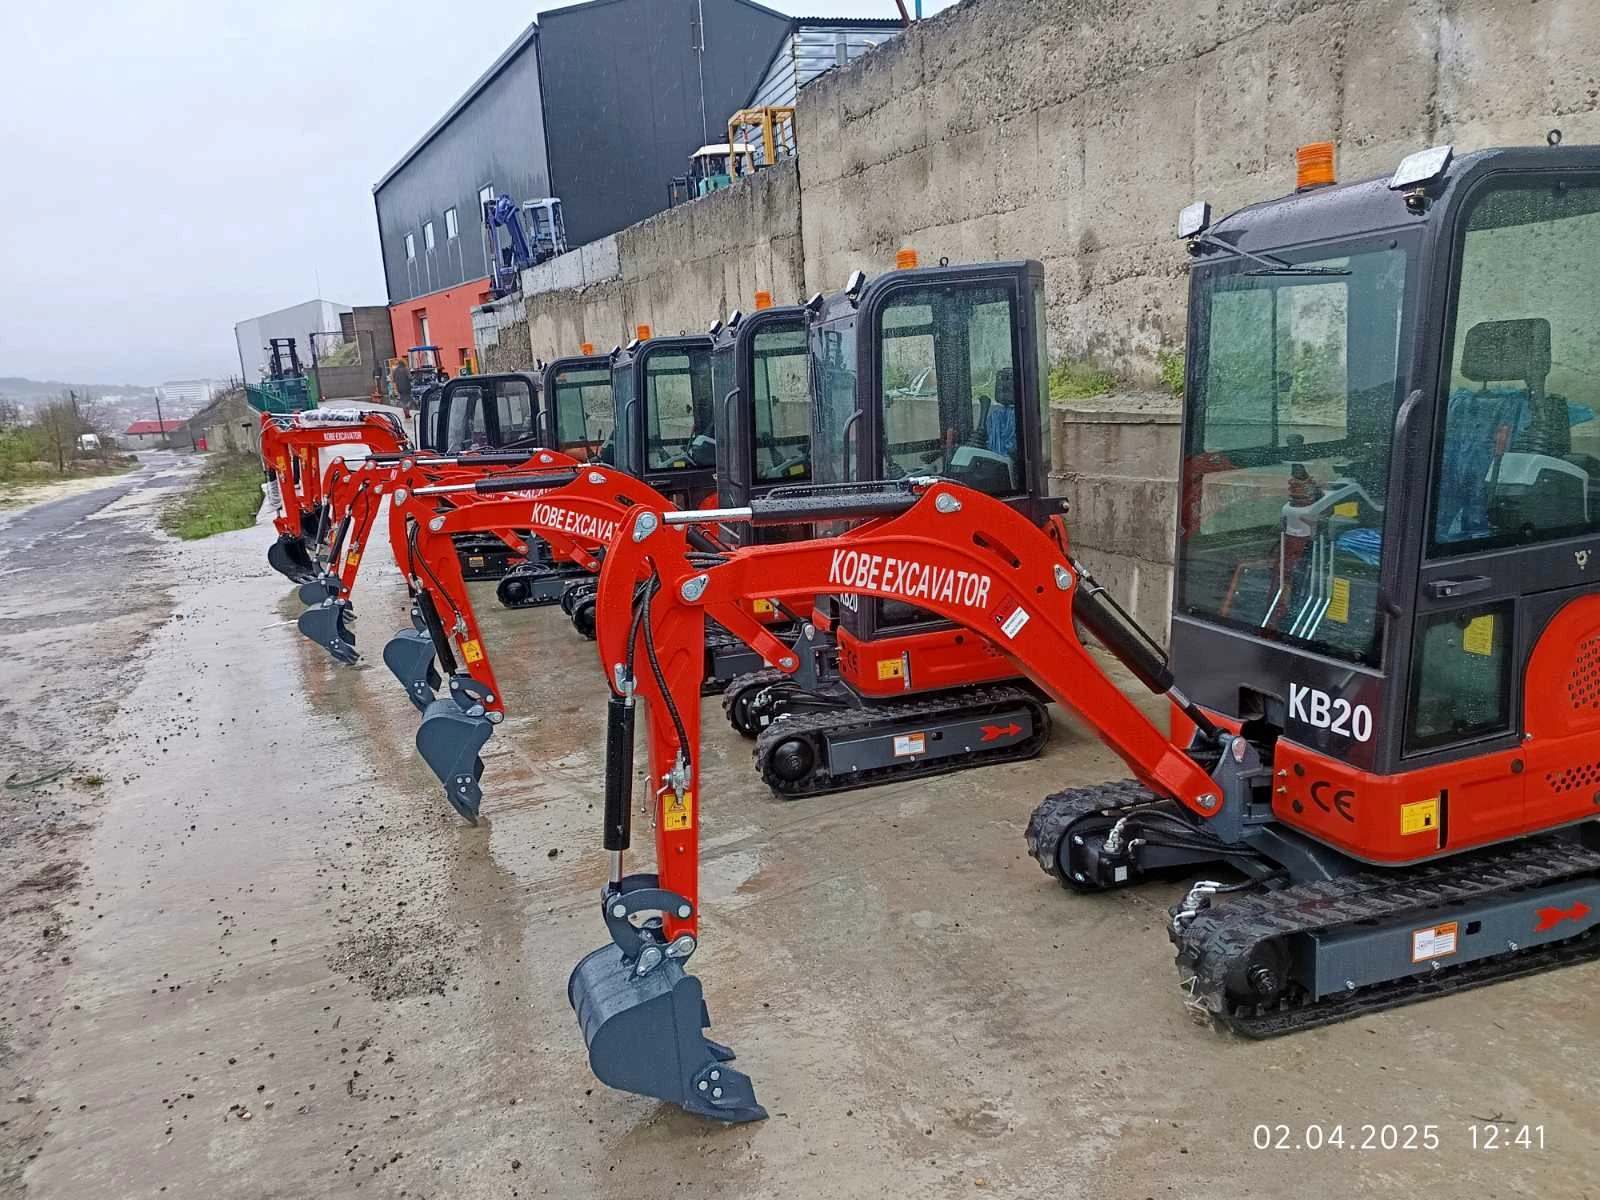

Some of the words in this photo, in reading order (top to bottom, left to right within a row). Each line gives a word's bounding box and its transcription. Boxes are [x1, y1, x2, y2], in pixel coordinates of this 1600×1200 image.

[531, 502, 566, 529] KOBE
[828, 548, 882, 590] KOBE
[881, 556, 991, 609] EXCAVATOR
[1289, 682, 1373, 742] KB20
[1310, 780, 1356, 823] CE
